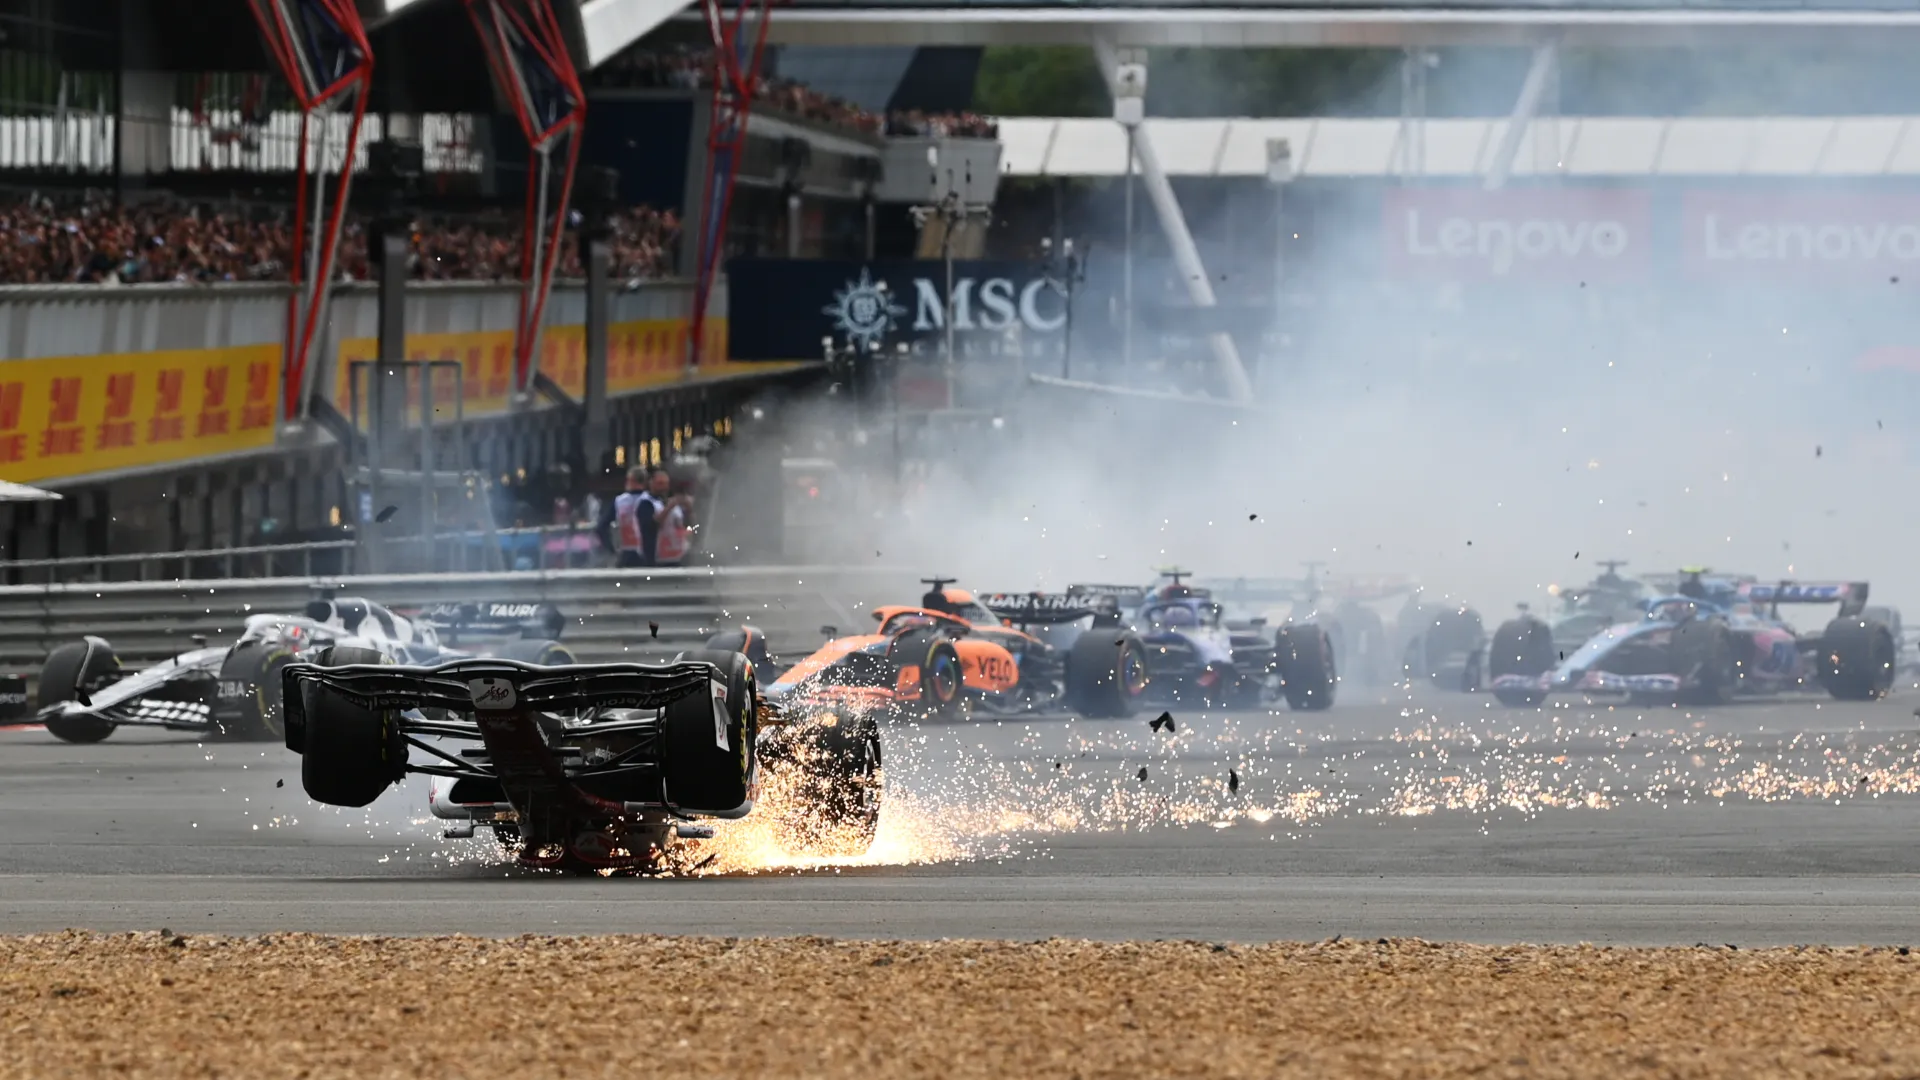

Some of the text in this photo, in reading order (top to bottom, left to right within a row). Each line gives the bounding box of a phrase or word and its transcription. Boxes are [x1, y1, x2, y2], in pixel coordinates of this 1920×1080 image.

[1406, 209, 1629, 258] Lenovo
[1704, 214, 1920, 261] Lenovo
[911, 277, 1068, 331] MSC
[987, 595, 1103, 610] DARTRACE
[977, 655, 1012, 683] VELO
